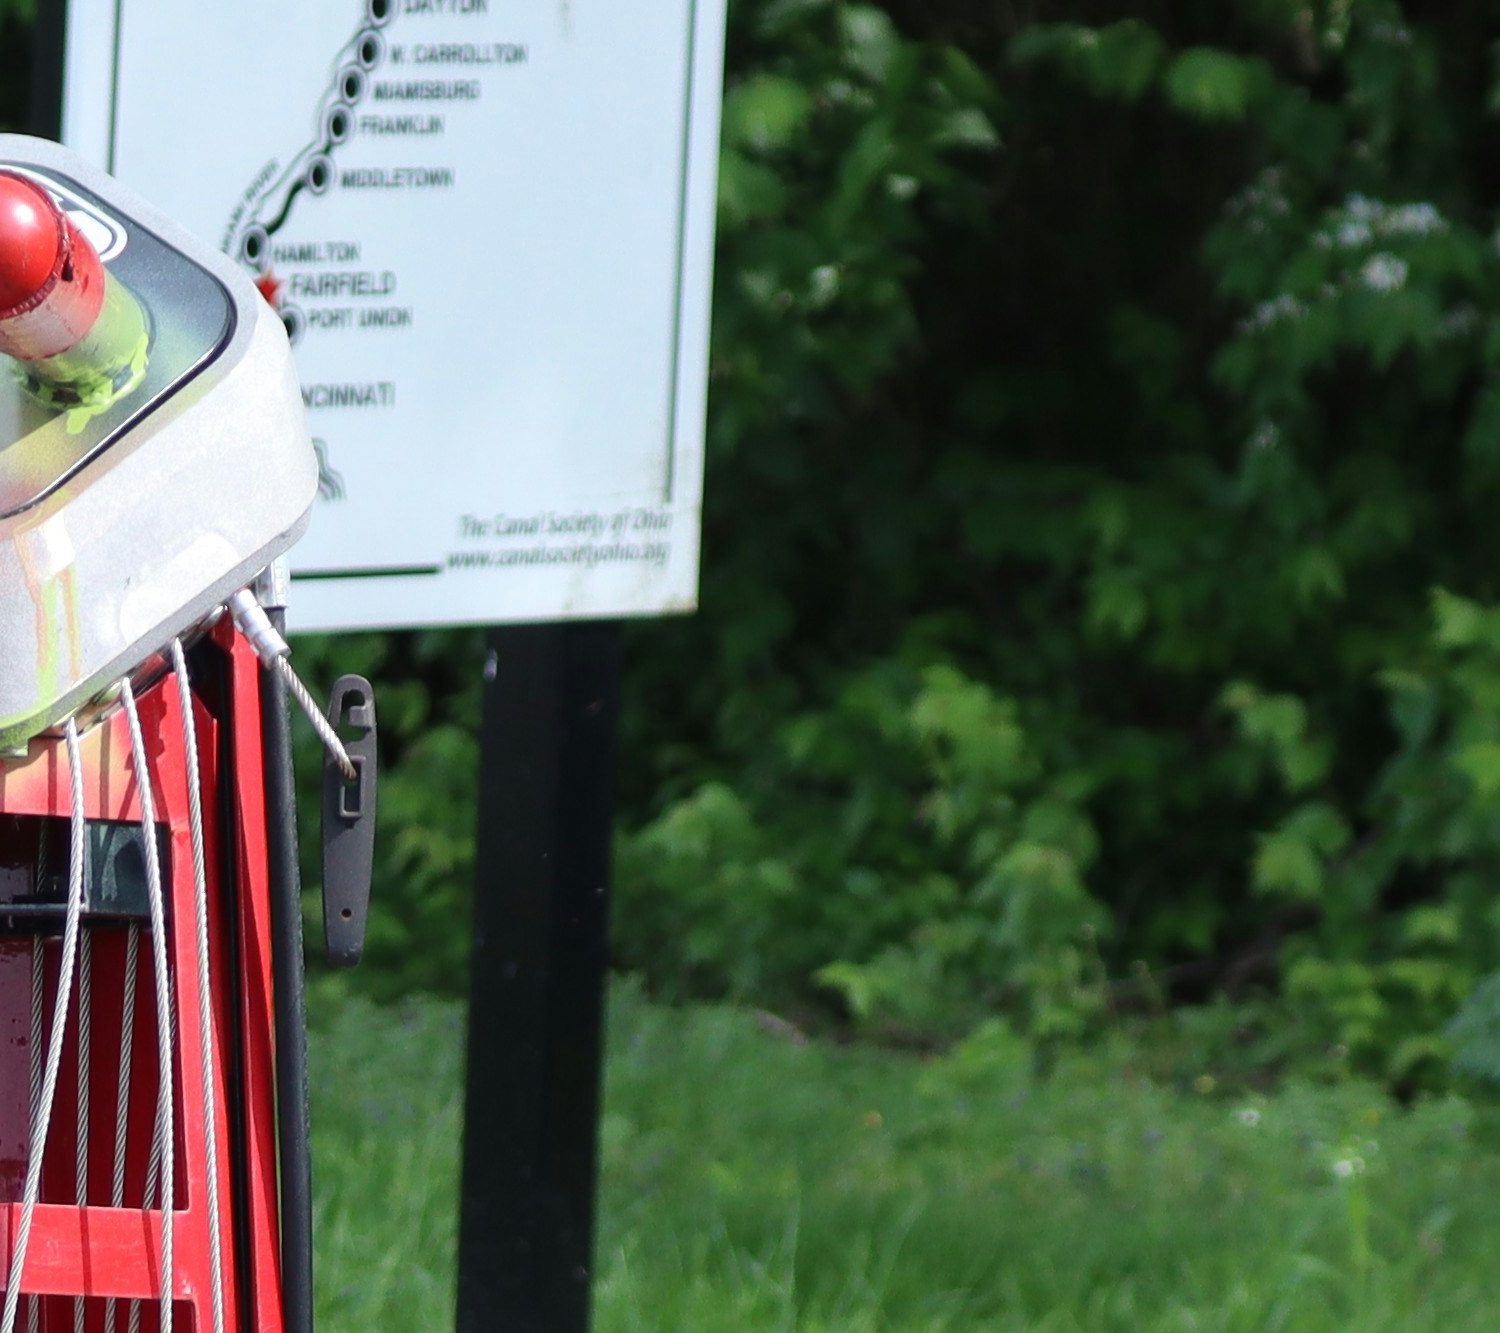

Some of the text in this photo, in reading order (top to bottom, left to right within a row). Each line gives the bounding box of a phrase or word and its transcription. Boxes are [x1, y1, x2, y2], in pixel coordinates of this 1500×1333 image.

[413, 43, 529, 64] CARROLLTON
[374, 80, 480, 101] MIAMISBURG
[360, 114, 444, 136] FRANKLIN
[341, 167, 455, 188] MIDDLETOWN
[273, 242, 360, 263] HAMILTON
[290, 271, 396, 297] FAIRFIELD
[308, 306, 412, 328] PORT UNION
[300, 381, 395, 408] NCINNATI
[460, 515, 488, 536] The
[495, 513, 543, 536] Canal
[546, 511, 607, 537] Society
